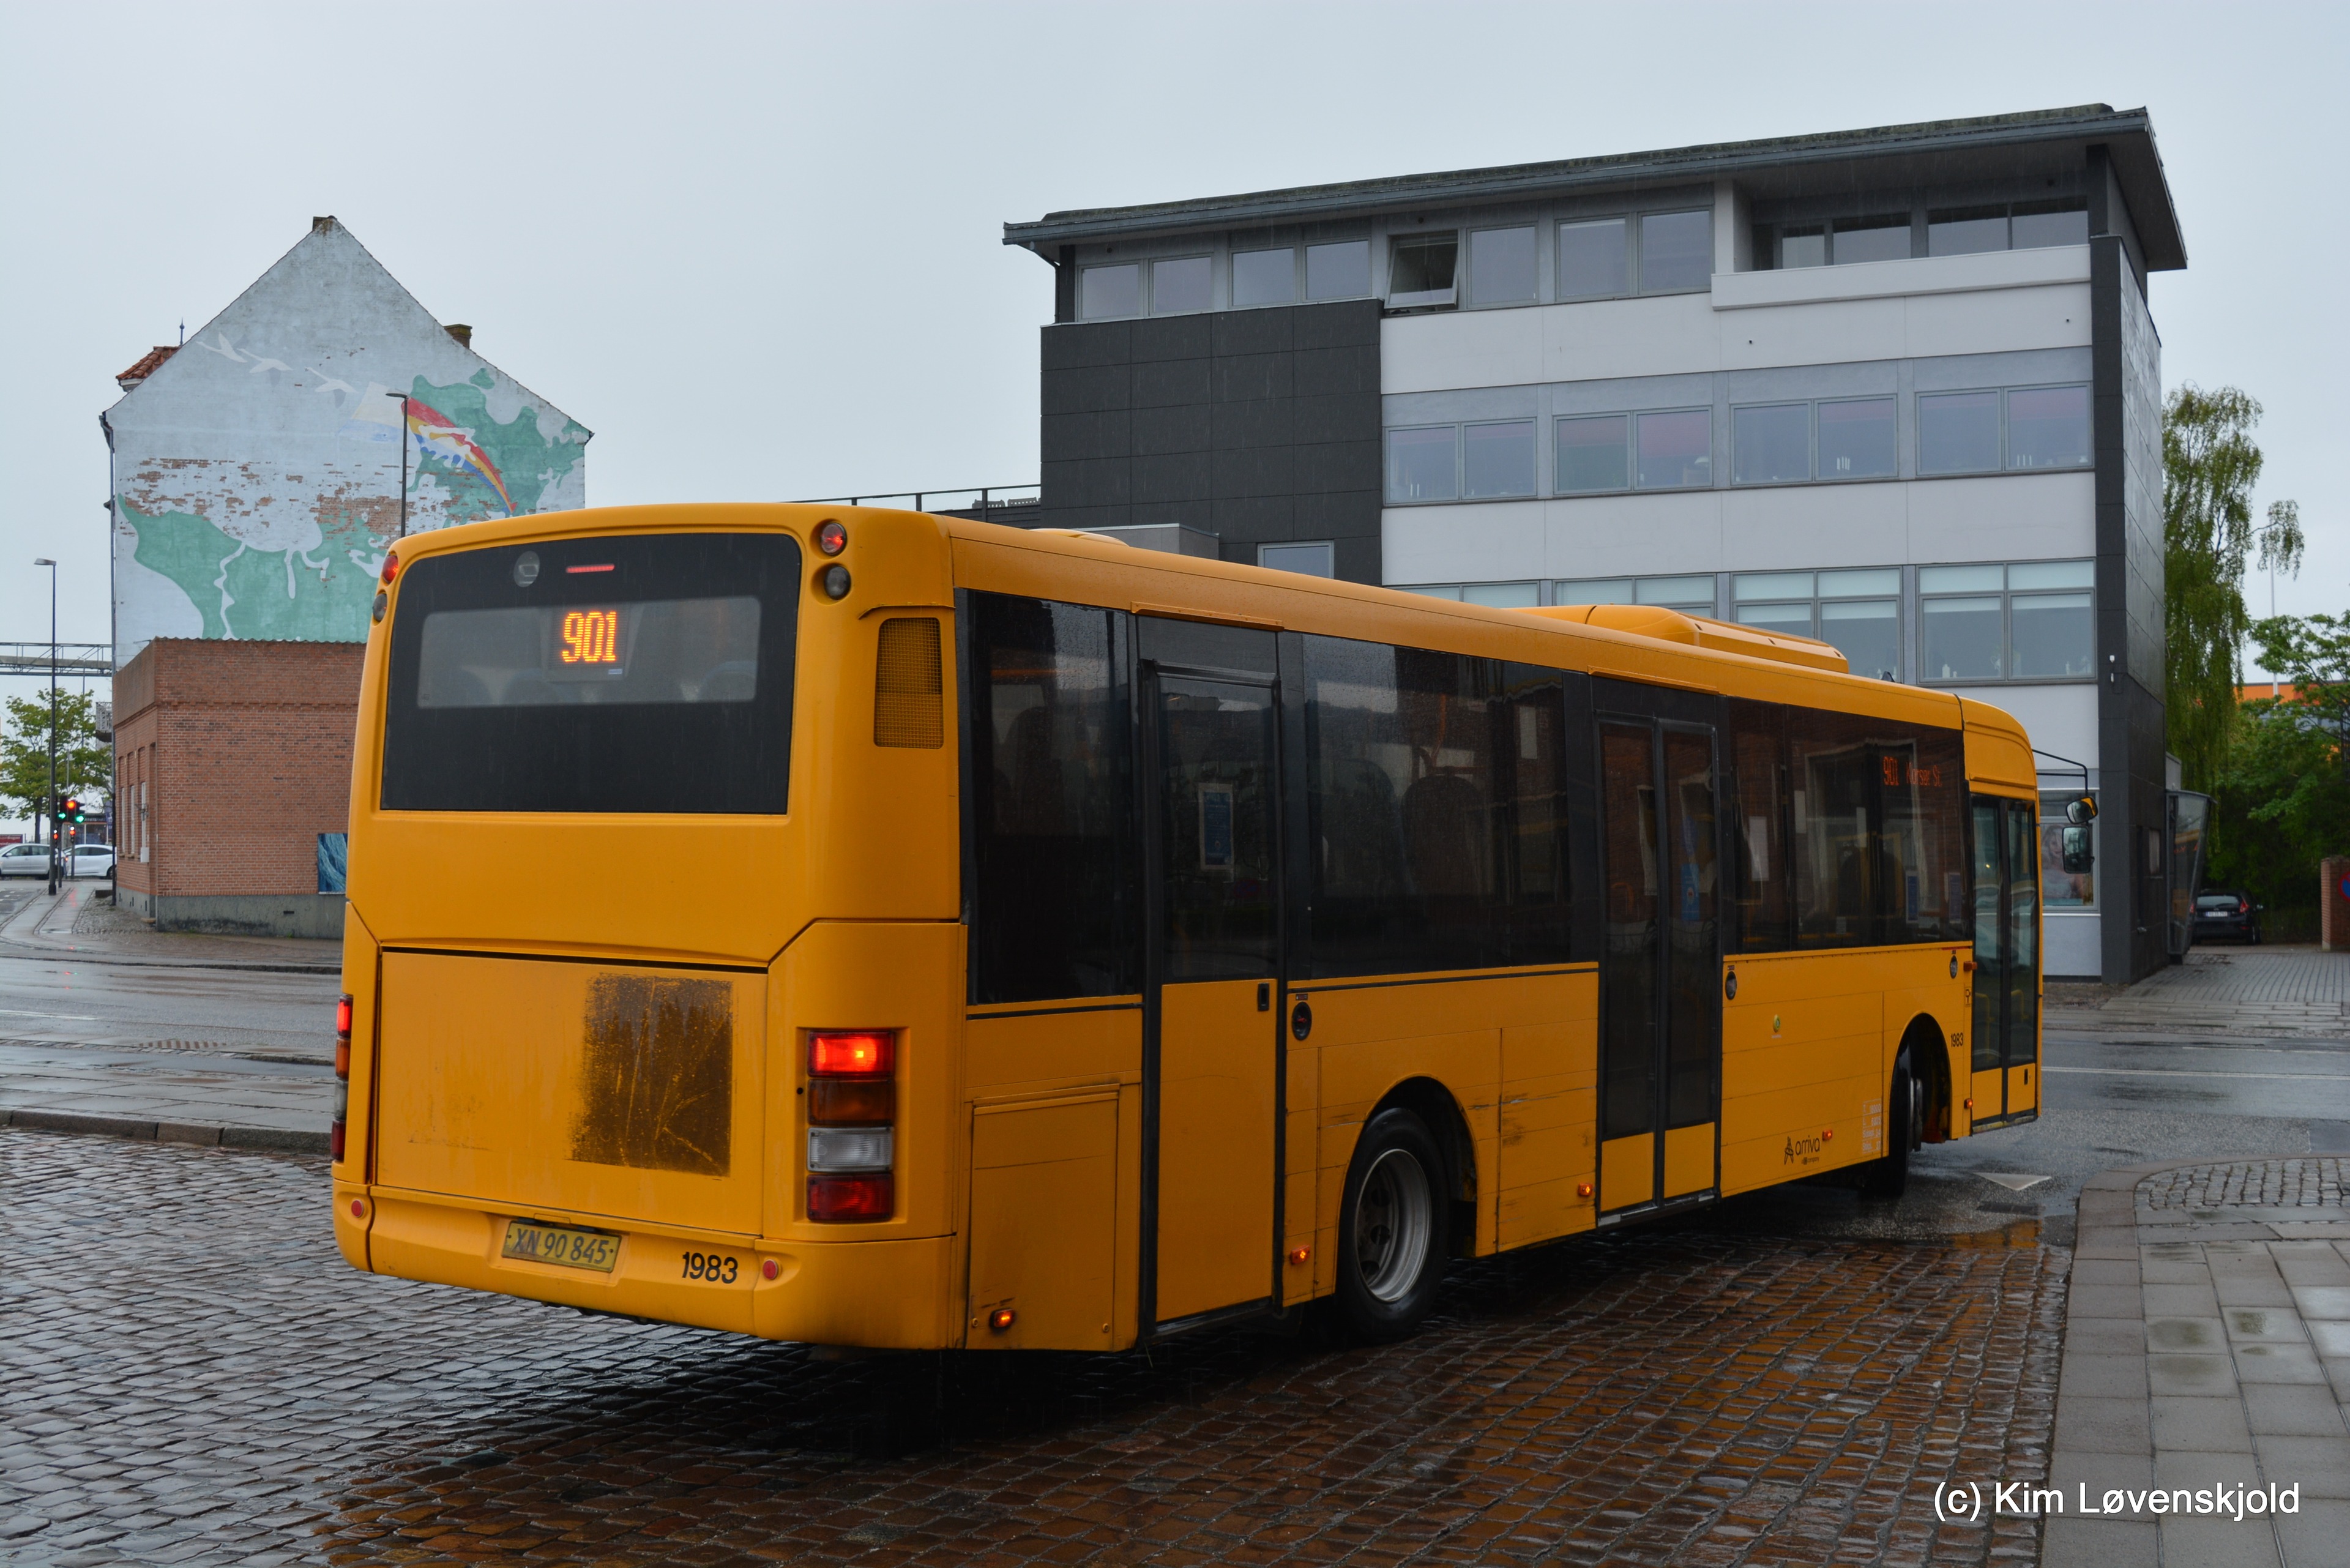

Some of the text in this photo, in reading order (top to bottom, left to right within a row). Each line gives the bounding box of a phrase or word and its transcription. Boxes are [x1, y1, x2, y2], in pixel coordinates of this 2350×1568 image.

[562, 611, 616, 662] 901
[1883, 756, 1899, 786] 901
[1950, 1032, 1964, 1048] 1983
[1795, 1135, 1820, 1155] arriva
[511, 1228, 610, 1264] XN 90 845
[682, 1252, 738, 1284] 1983
